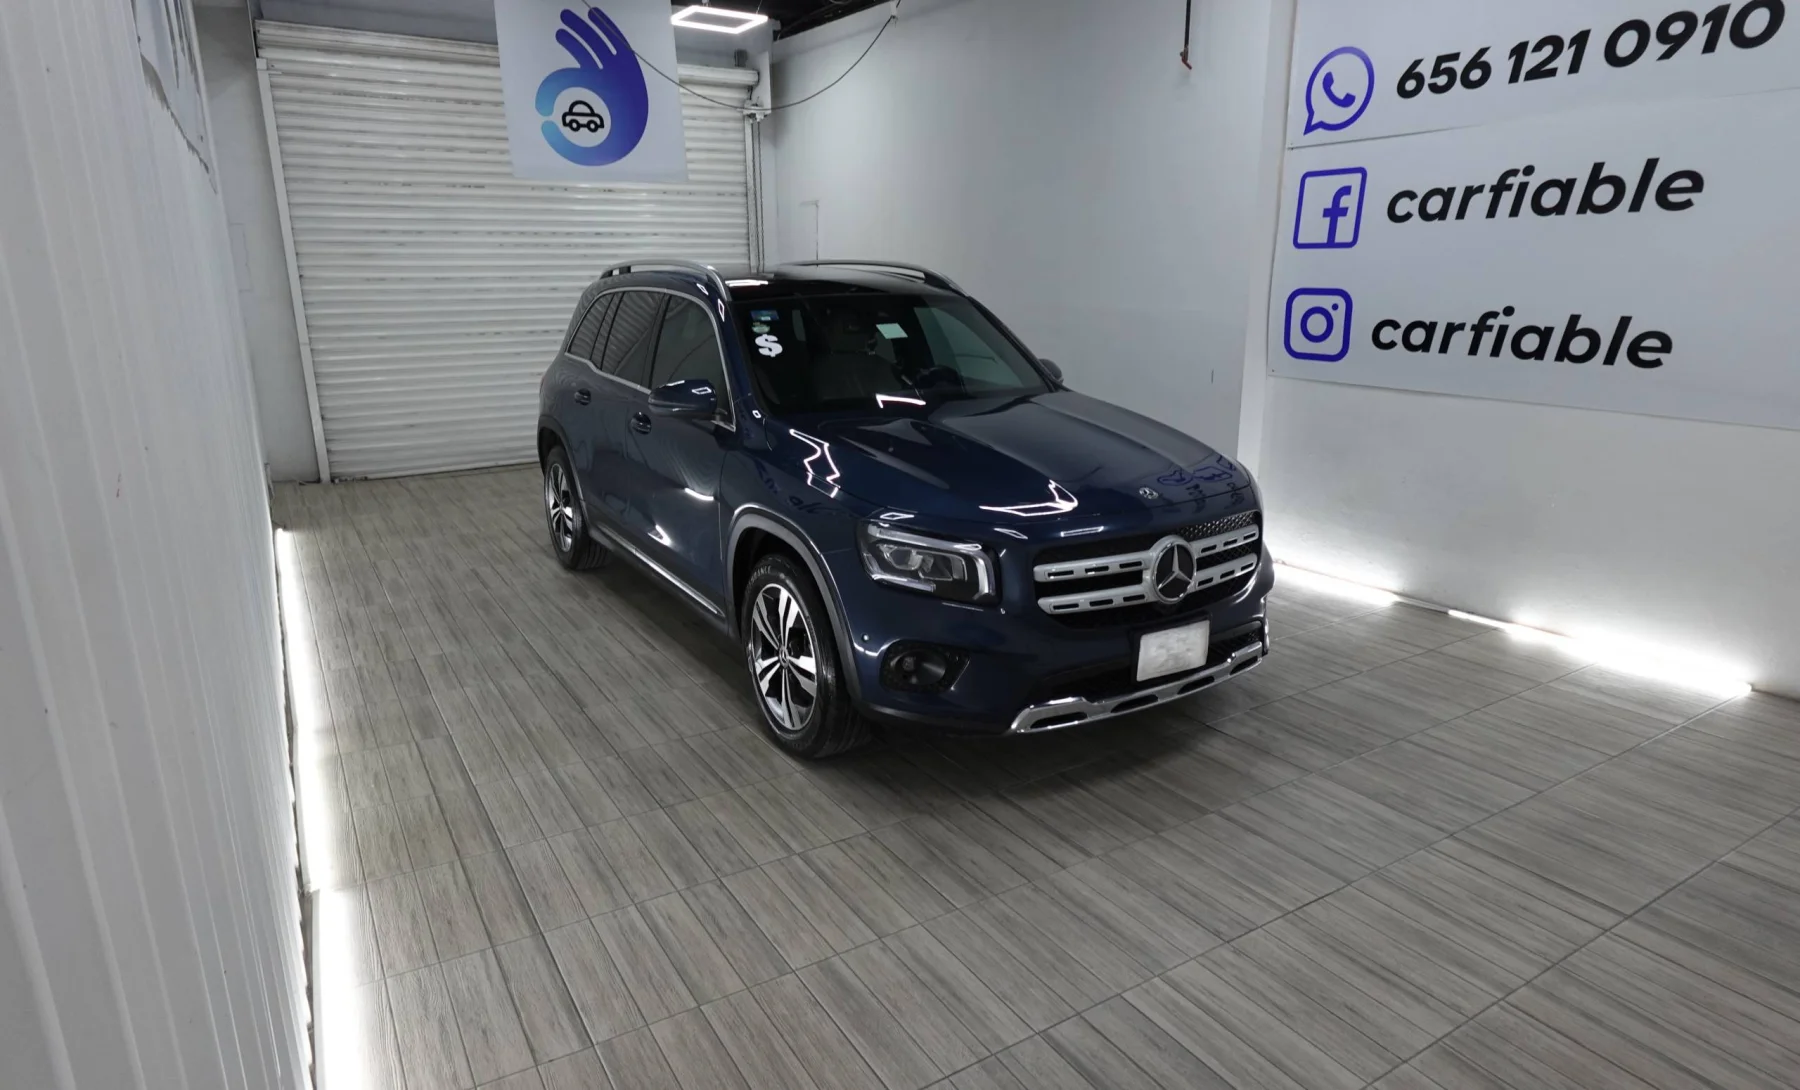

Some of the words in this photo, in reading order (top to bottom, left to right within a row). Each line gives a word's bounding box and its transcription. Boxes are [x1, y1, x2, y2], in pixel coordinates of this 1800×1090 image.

[1396, 46, 1492, 99] 656
[1507, 28, 1592, 85] 121
[1603, 0, 1786, 68] 0910
[1386, 157, 1704, 223] carfiable
[1371, 305, 1673, 369] carfiable
